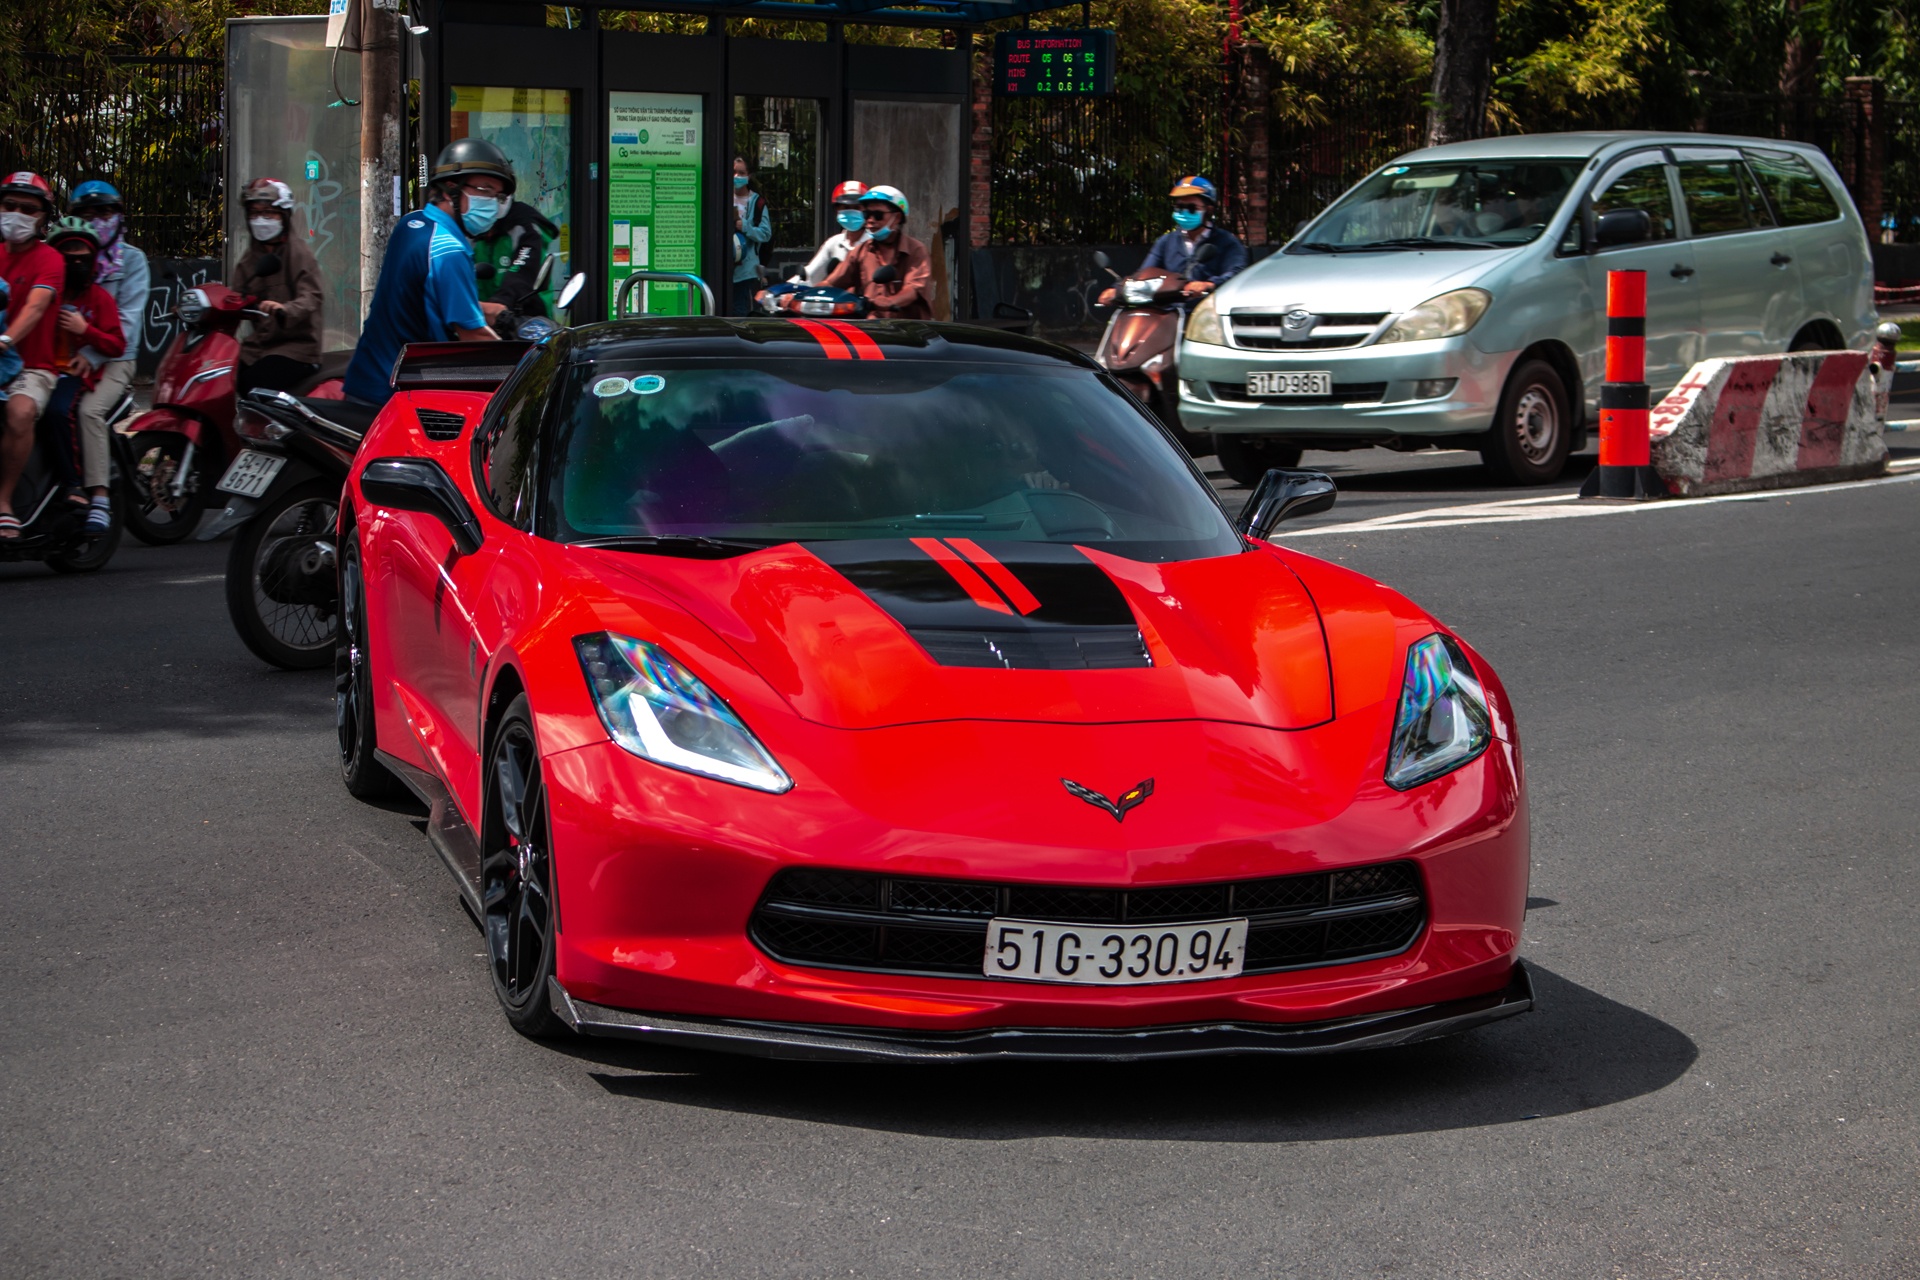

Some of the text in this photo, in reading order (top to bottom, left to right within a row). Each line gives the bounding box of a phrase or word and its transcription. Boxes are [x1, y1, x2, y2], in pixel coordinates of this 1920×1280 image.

[1017, 39, 1082, 49] BUS INFORMATION
[1008, 54, 1031, 63] ROUTE
[1063, 53, 1073, 62] 06
[1084, 53, 1095, 62] 52
[1008, 67, 1094, 77] MINS 1 2 6
[1008, 82, 1094, 91] KM 0.2 0.6 1.4
[225, 471, 263, 493] 9671
[997, 927, 1234, 978] 51G-330.94
